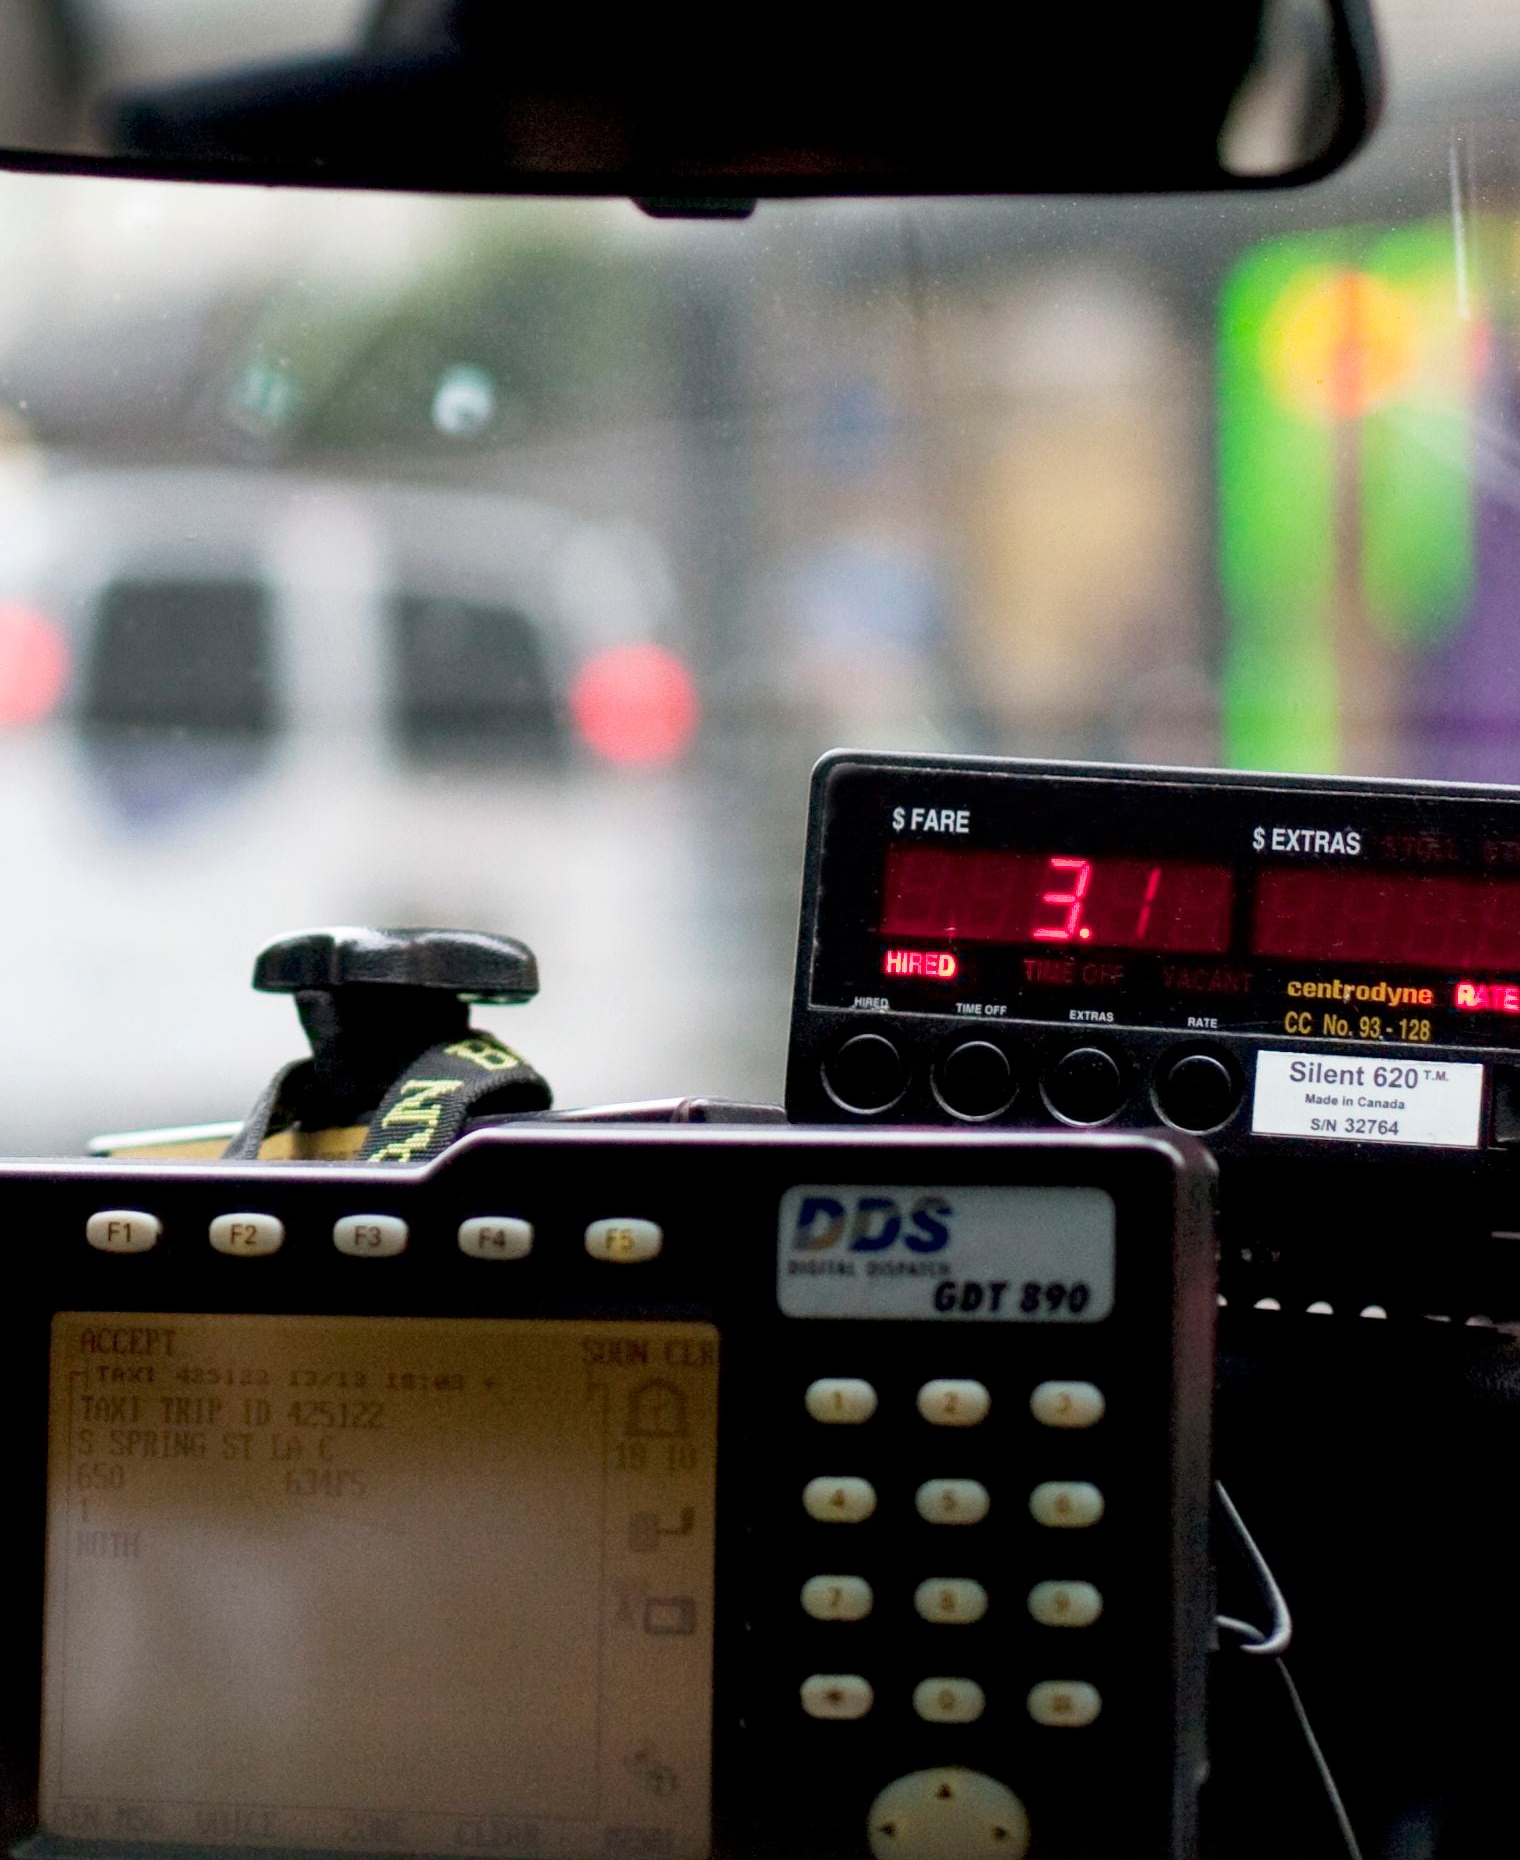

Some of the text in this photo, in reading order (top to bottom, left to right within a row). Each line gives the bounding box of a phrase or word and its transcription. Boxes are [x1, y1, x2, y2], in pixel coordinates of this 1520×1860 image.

[892, 807, 971, 834] $ FARE
[1252, 826, 1266, 852] $
[1271, 828, 1362, 856] EXTRAS
[885, 950, 956, 978] HIRED
[854, 995, 890, 1009] HIRED
[1287, 979, 1433, 1007] centrodyne
[1456, 983, 1520, 1013] RATE
[955, 1002, 1007, 1017] TIME OFF
[1069, 1009, 1115, 1023] EXTRAS
[1187, 1016, 1218, 1030] RATE
[1284, 1010, 1313, 1035] CC
[1323, 1014, 1353, 1037] No.
[1399, 1018, 1431, 1041] 128
[1289, 1061, 1365, 1086] Silent
[1373, 1066, 1419, 1089] 620
[1305, 1093, 1405, 1110] Made in Canada
[1310, 1118, 1399, 1136] S/N 32764
[107, 1221, 133, 1243] F1
[229, 1223, 258, 1246] F2
[354, 1225, 383, 1247] F3
[480, 1227, 506, 1249] F4
[792, 1196, 955, 1254] DDS
[605, 1229, 636, 1251] F5
[934, 1280, 1090, 1314] GDT 890
[80, 1327, 176, 1356] ACCEPT
[80, 1396, 140, 1423] TAXI
[160, 1397, 223, 1425] TRIP
[243, 1398, 272, 1426] ID
[109, 1430, 207, 1458] SPRING
[222, 1432, 254, 1461] ST
[270, 1433, 303, 1461] LA
